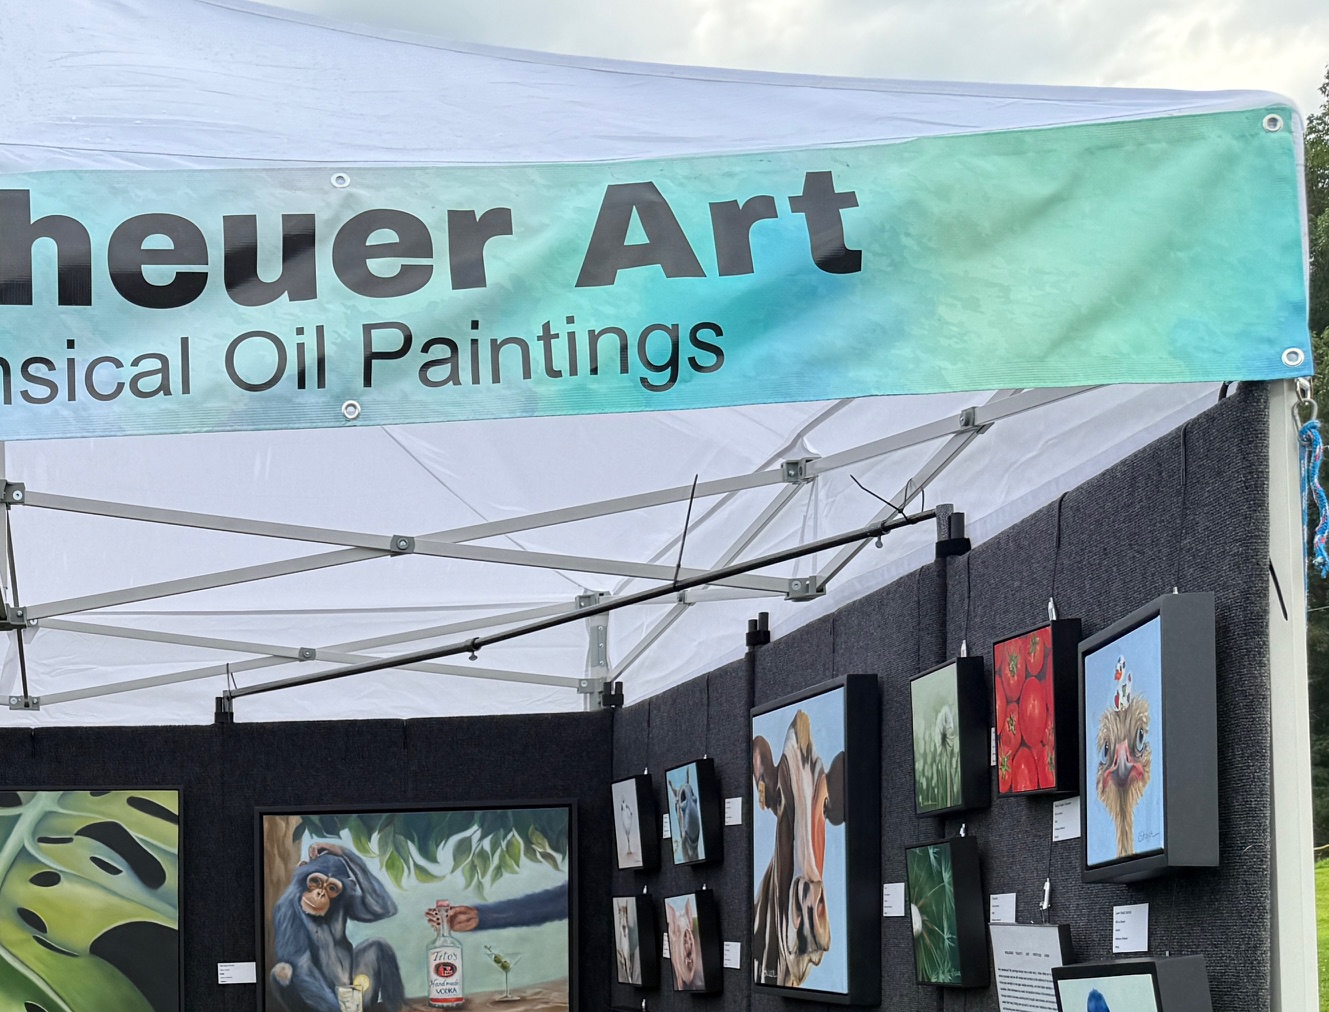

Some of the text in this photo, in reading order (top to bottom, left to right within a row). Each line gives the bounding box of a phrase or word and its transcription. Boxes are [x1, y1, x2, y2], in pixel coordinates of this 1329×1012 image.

[574, 169, 863, 288] Art
[224, 323, 327, 394] Oil
[361, 314, 725, 393] Paintings
